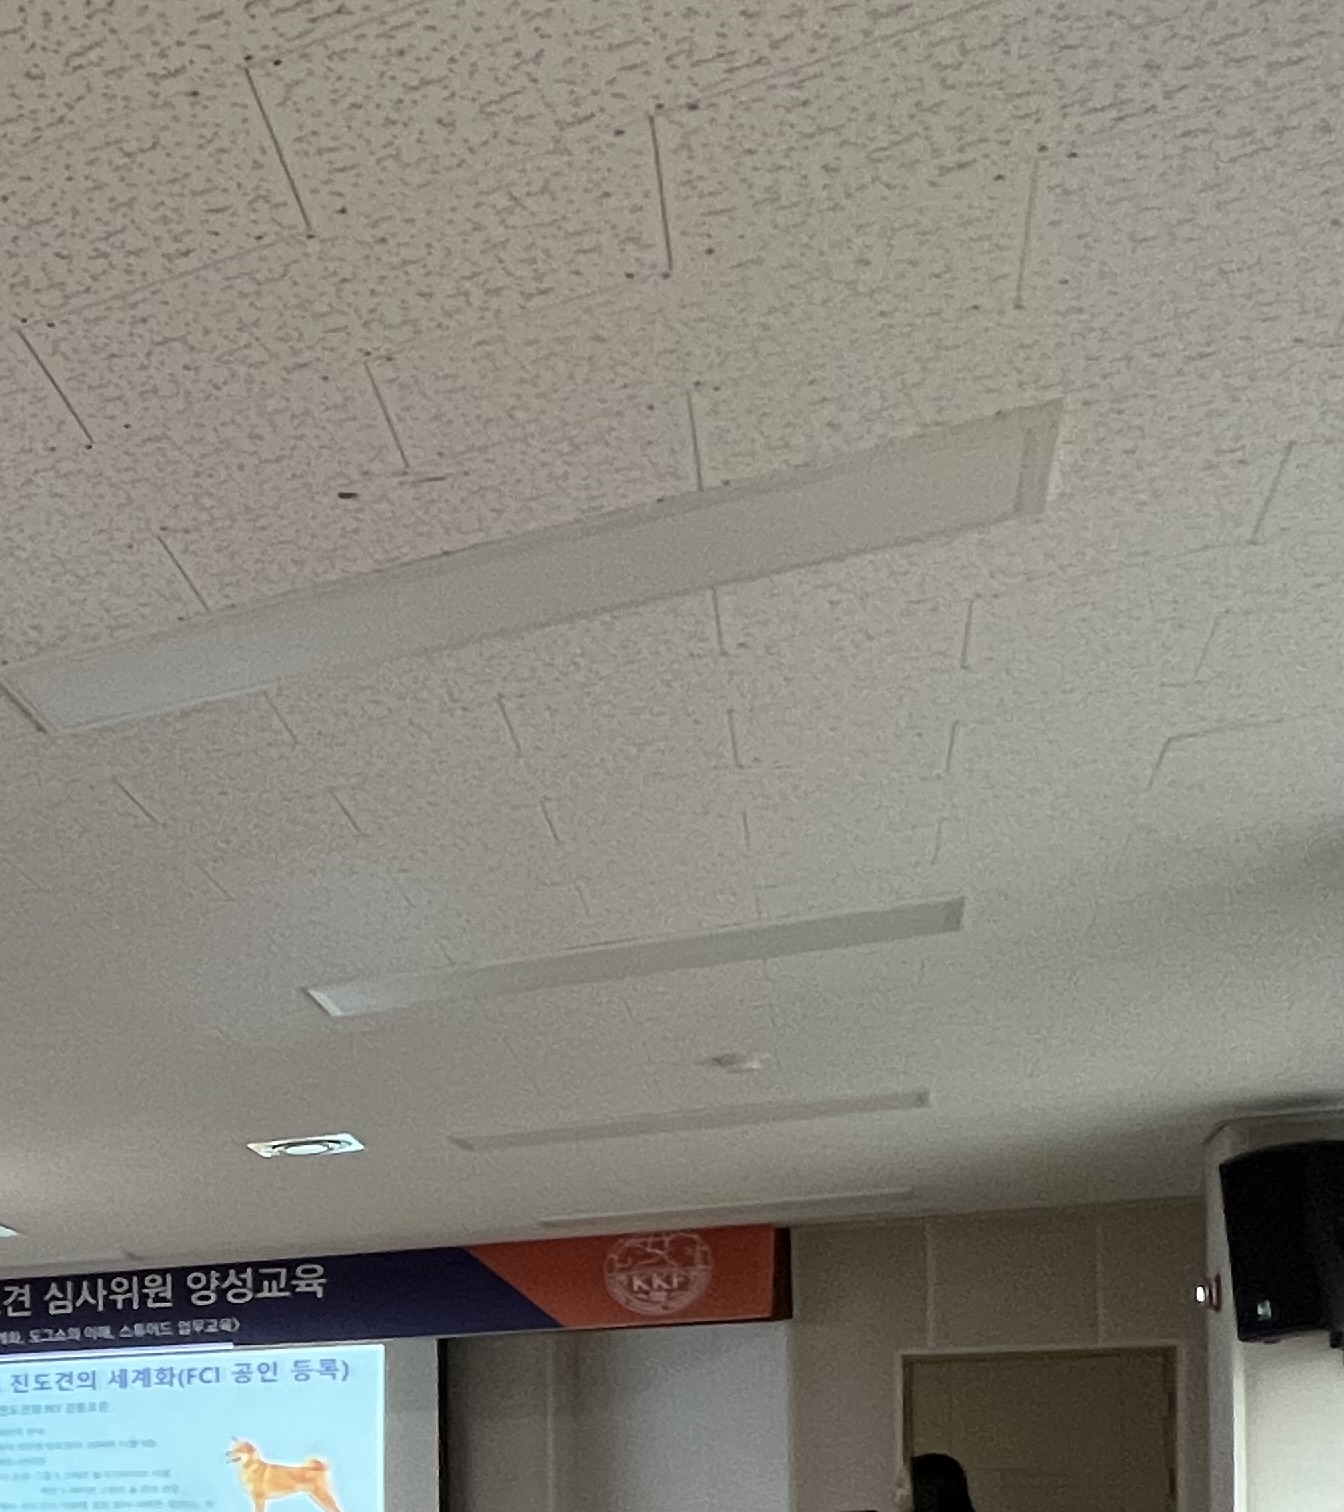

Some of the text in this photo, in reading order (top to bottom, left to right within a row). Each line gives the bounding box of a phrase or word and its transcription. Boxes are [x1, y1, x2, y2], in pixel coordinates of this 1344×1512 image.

[43, 1272, 174, 1315] 심사위원
[186, 1263, 328, 1306] 양성교육
[10, 1369, 98, 1394] 진도견의
[107, 1365, 221, 1390] 세계화(FCI
[230, 1360, 279, 1384] 공인
[289, 1357, 350, 1383] 등록)
